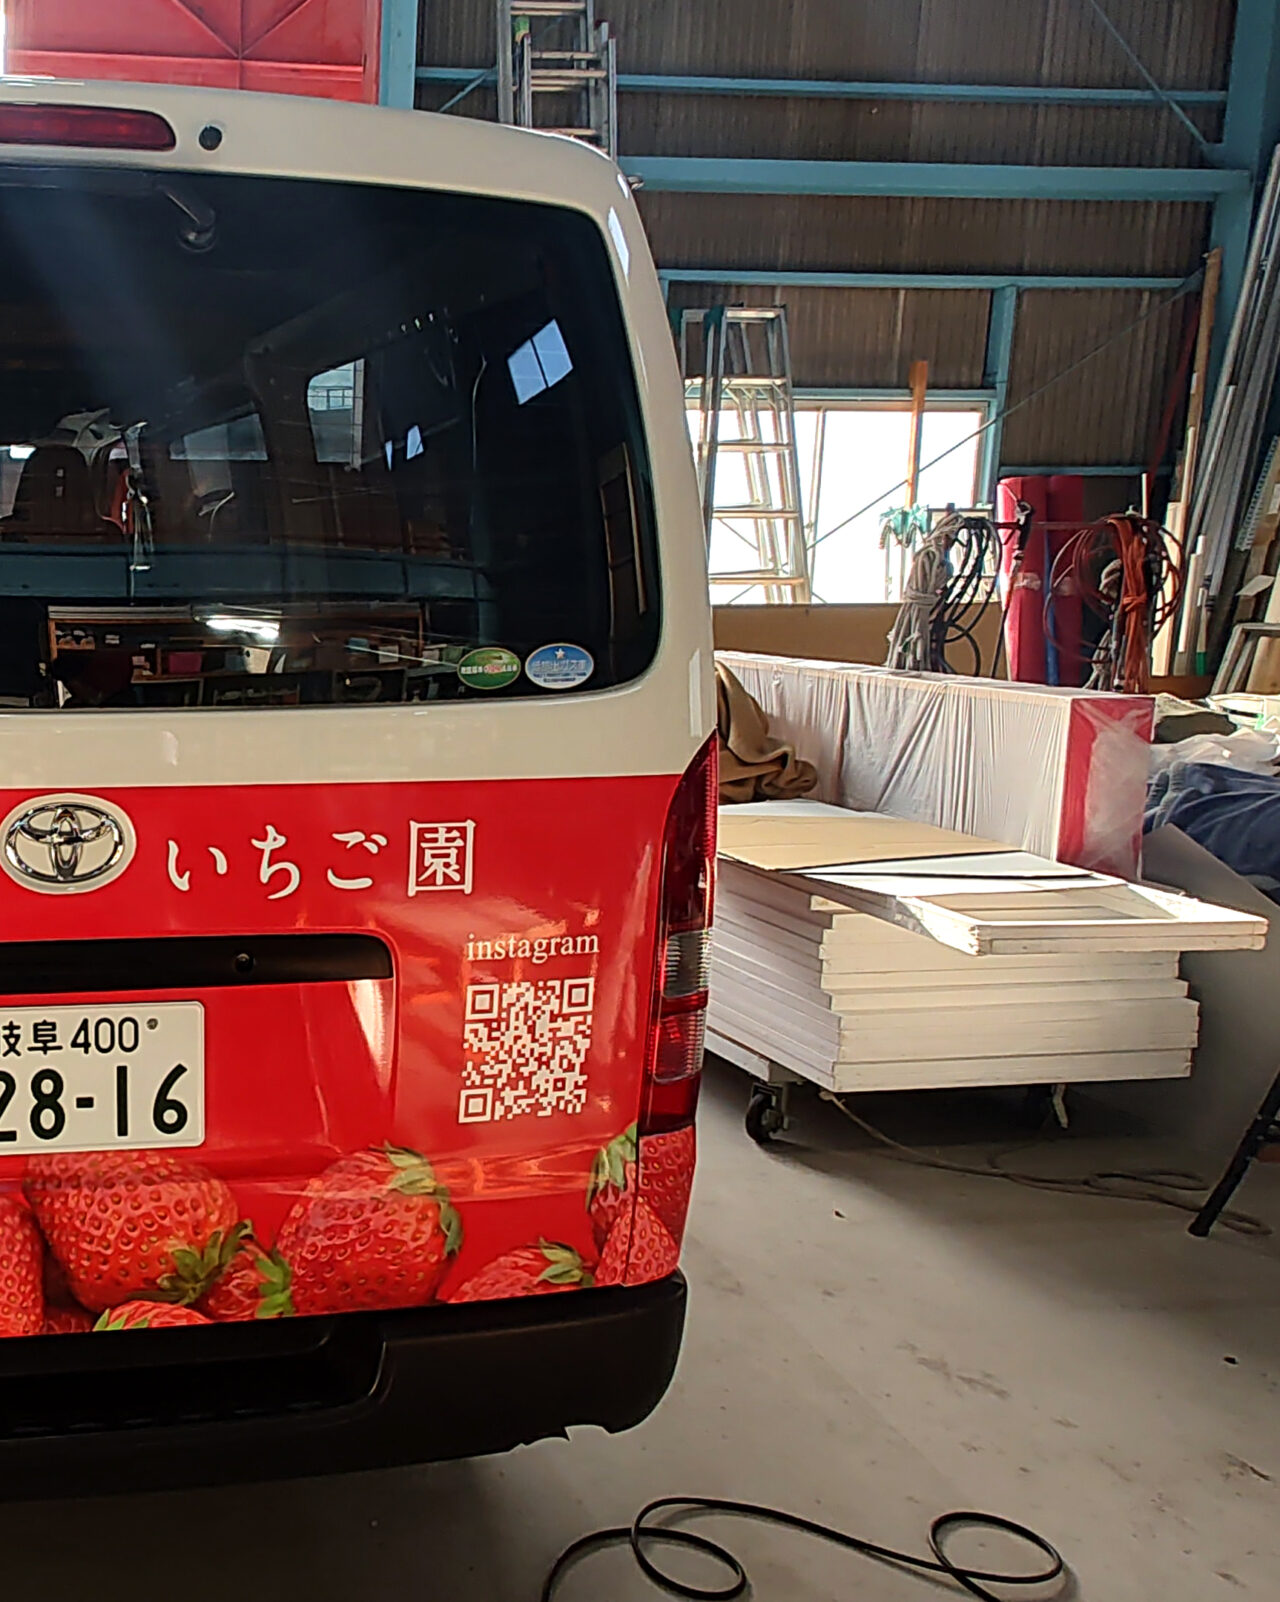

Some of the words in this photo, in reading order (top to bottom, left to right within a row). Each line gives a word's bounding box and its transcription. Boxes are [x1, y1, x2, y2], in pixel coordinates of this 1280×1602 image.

[167, 819, 477, 897] いちご園
[466, 933, 600, 964] instagram
